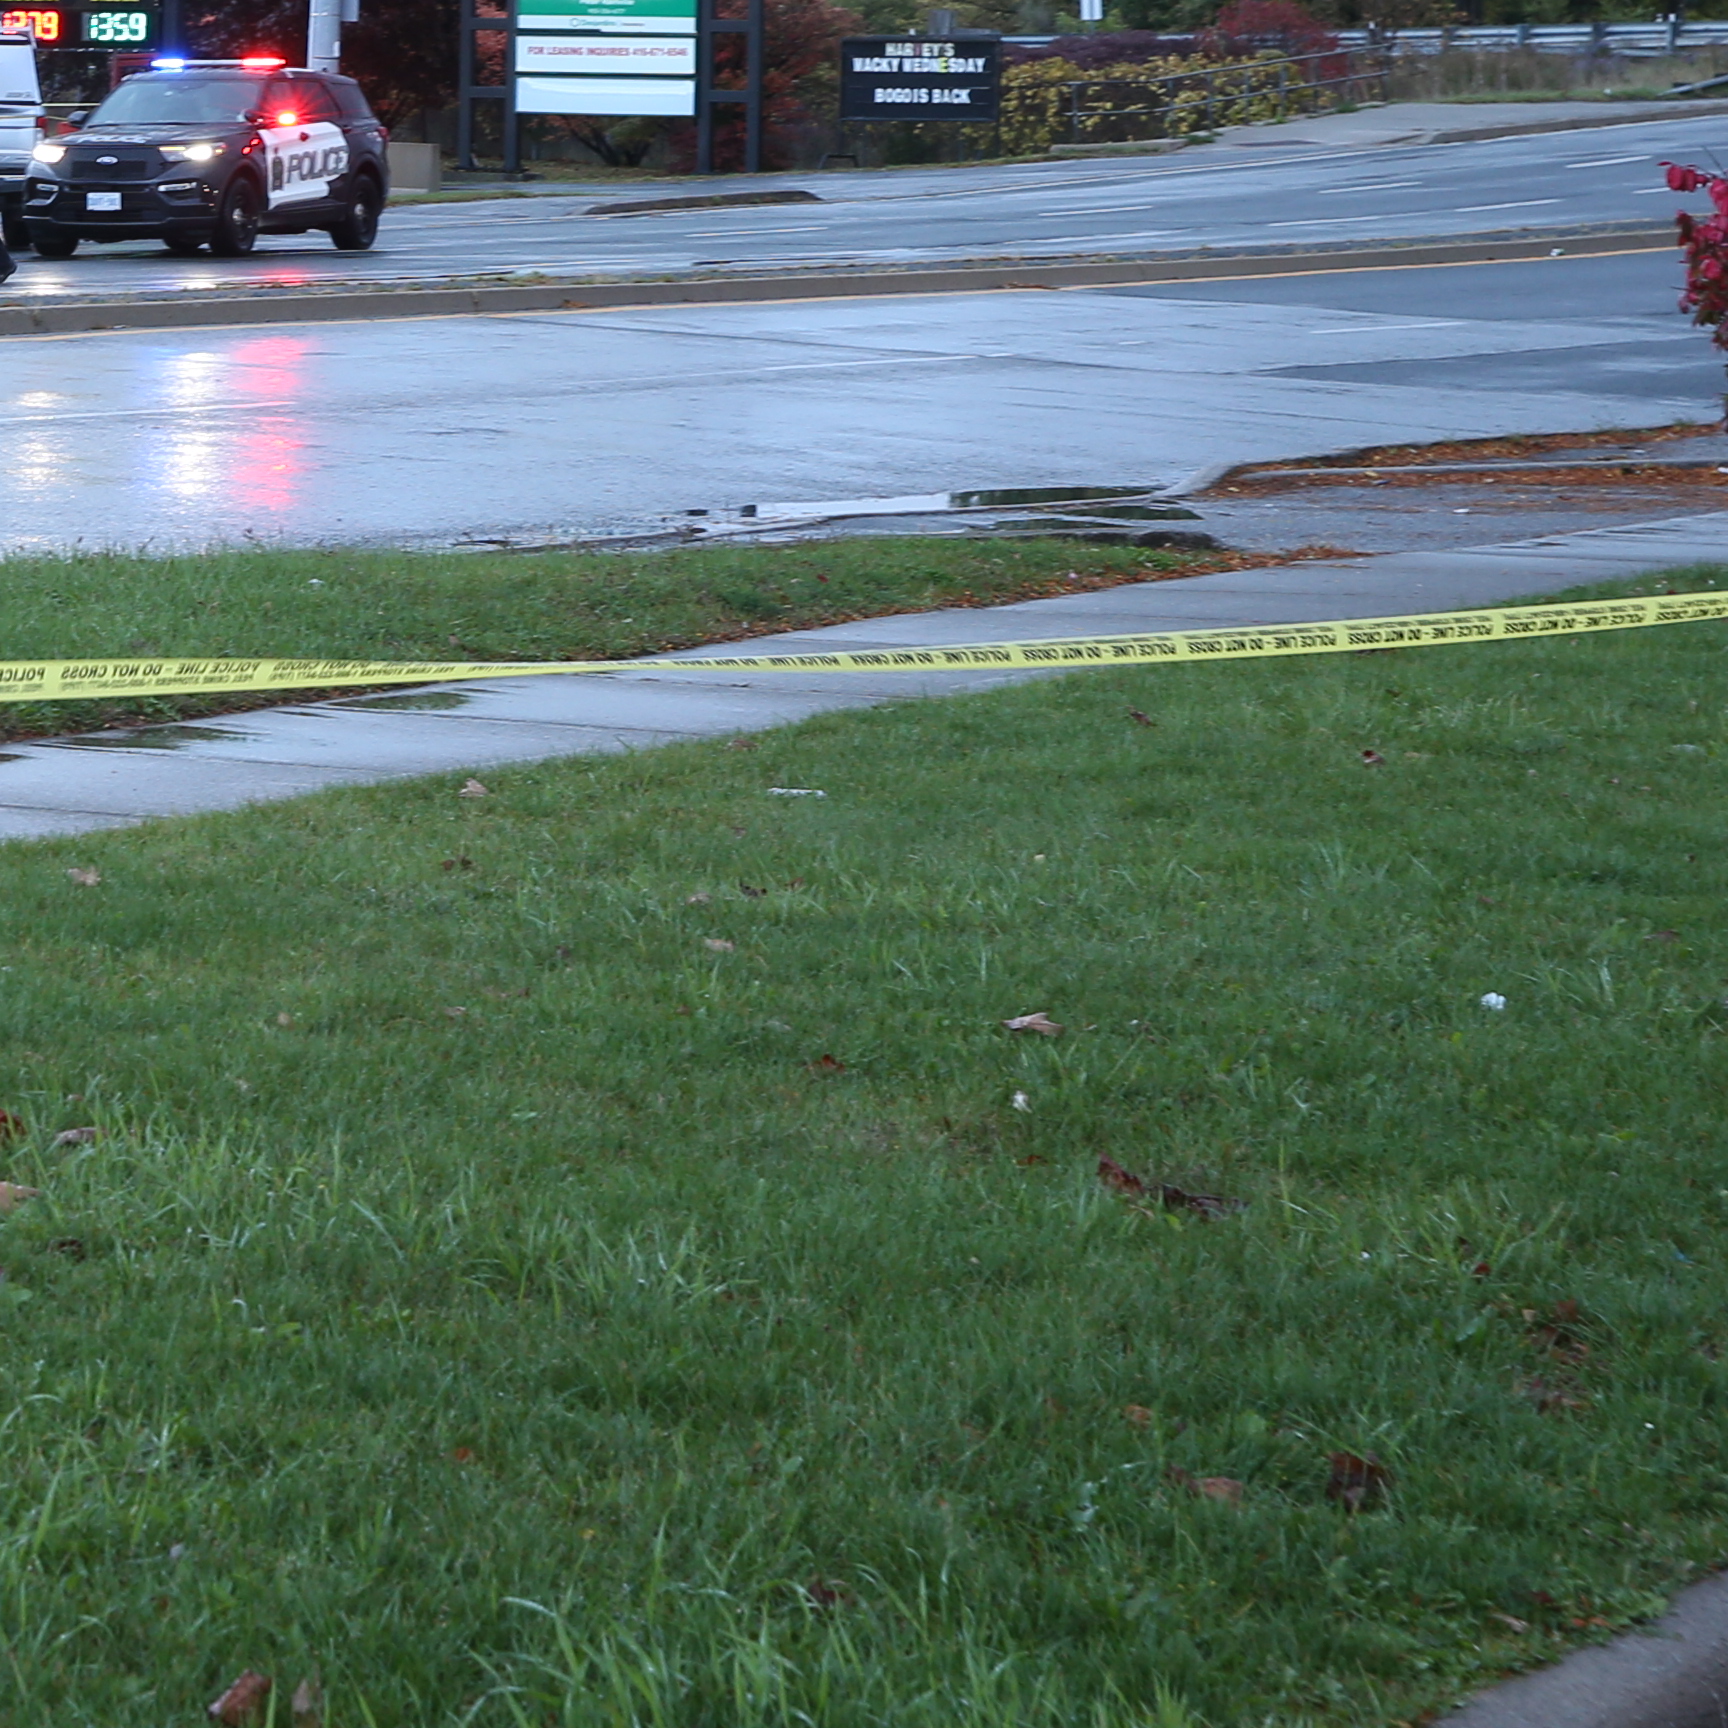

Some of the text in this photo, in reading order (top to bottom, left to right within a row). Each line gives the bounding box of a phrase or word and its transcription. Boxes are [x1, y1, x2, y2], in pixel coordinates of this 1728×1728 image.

[90, 12, 148, 41] 1359
[527, 47, 544, 56] FOR
[852, 57, 986, 72] WACKY WEDNESDAY
[931, 88, 971, 104] BACK
[285, 146, 350, 183] POLICE
